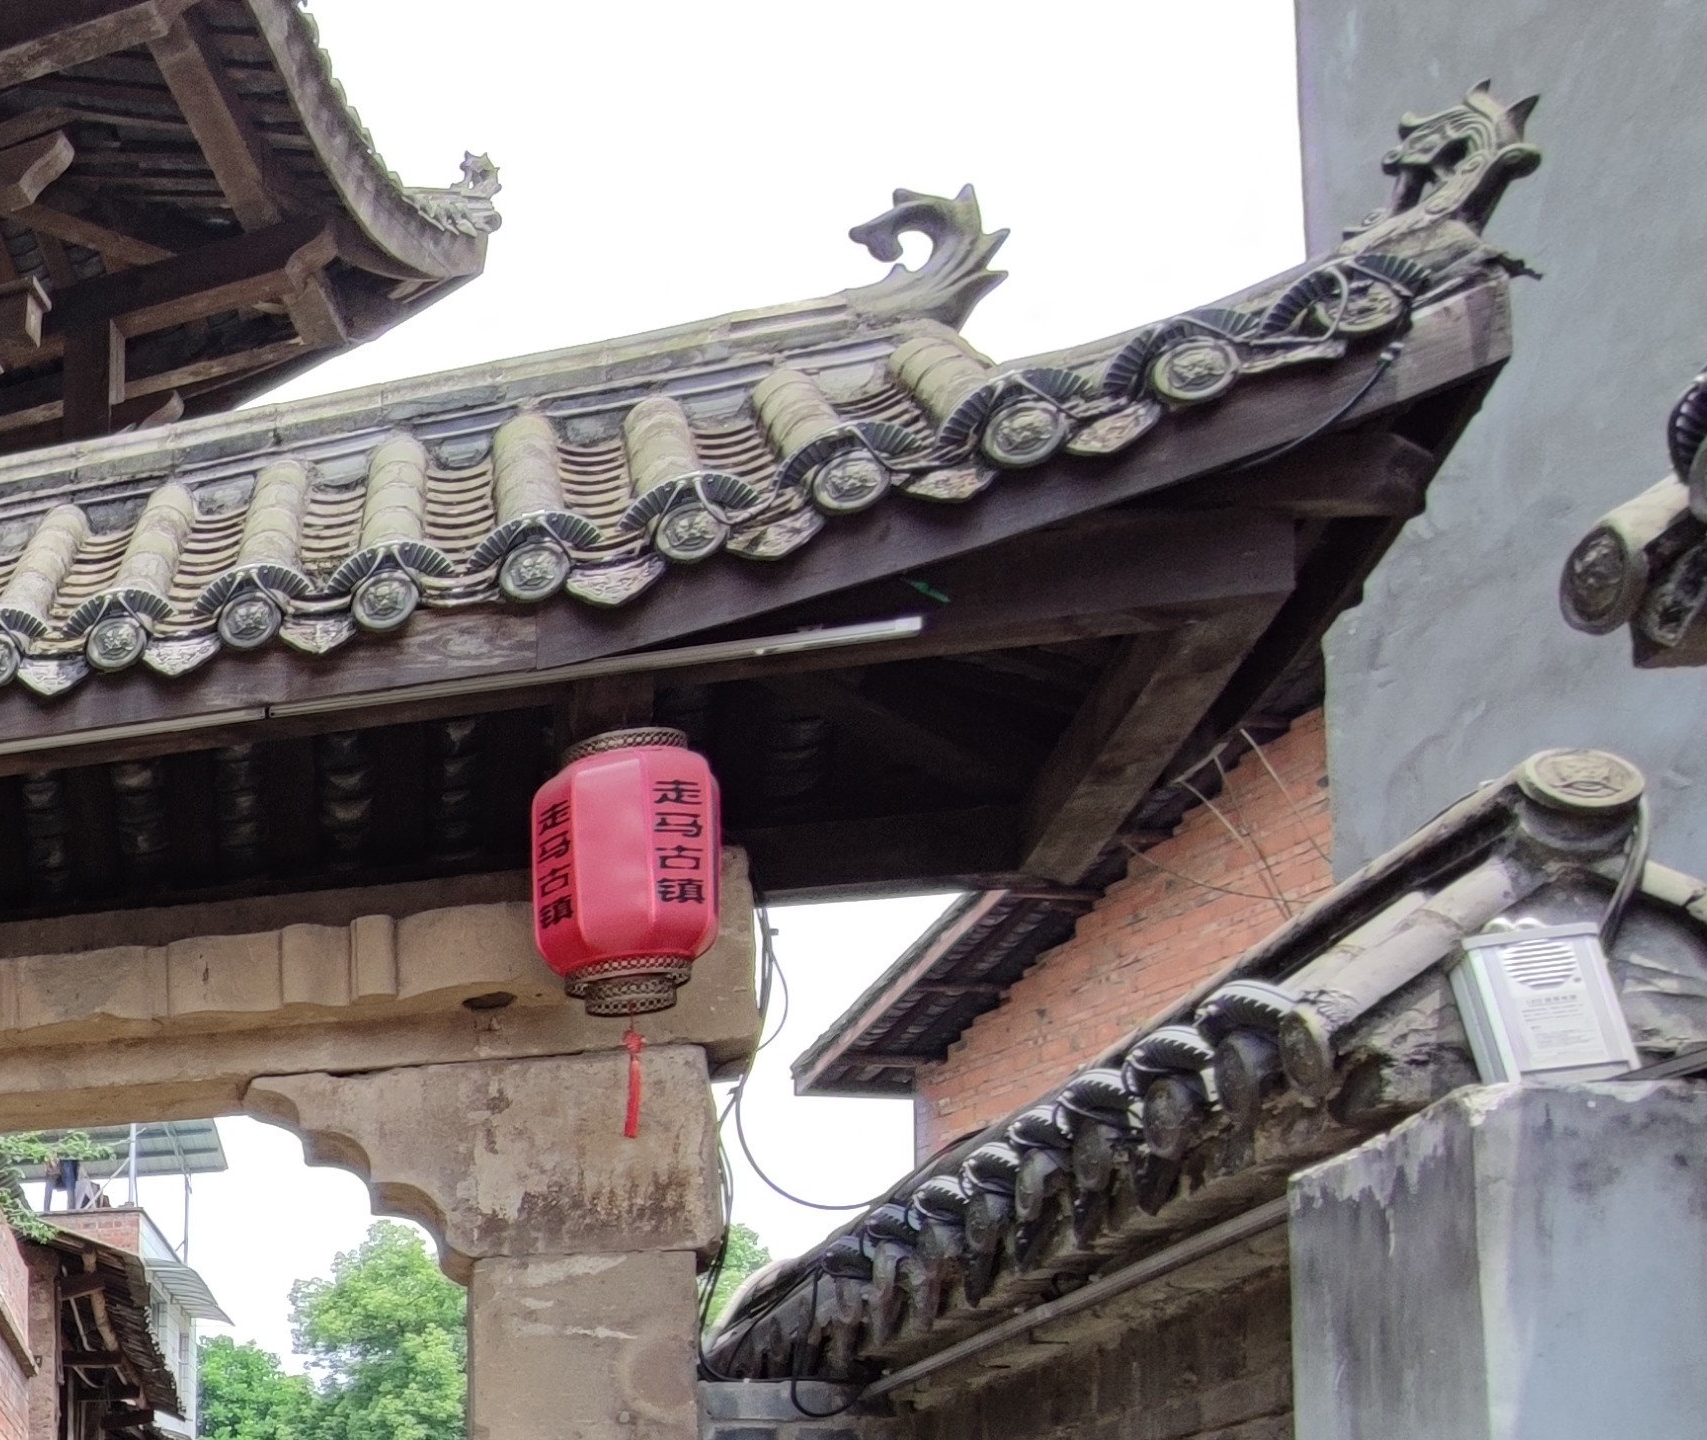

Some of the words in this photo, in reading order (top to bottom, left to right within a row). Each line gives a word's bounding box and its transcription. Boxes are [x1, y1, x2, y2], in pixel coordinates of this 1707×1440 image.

[537, 799, 573, 930] 走马古镇
[653, 778, 705, 905] 走马古镇
